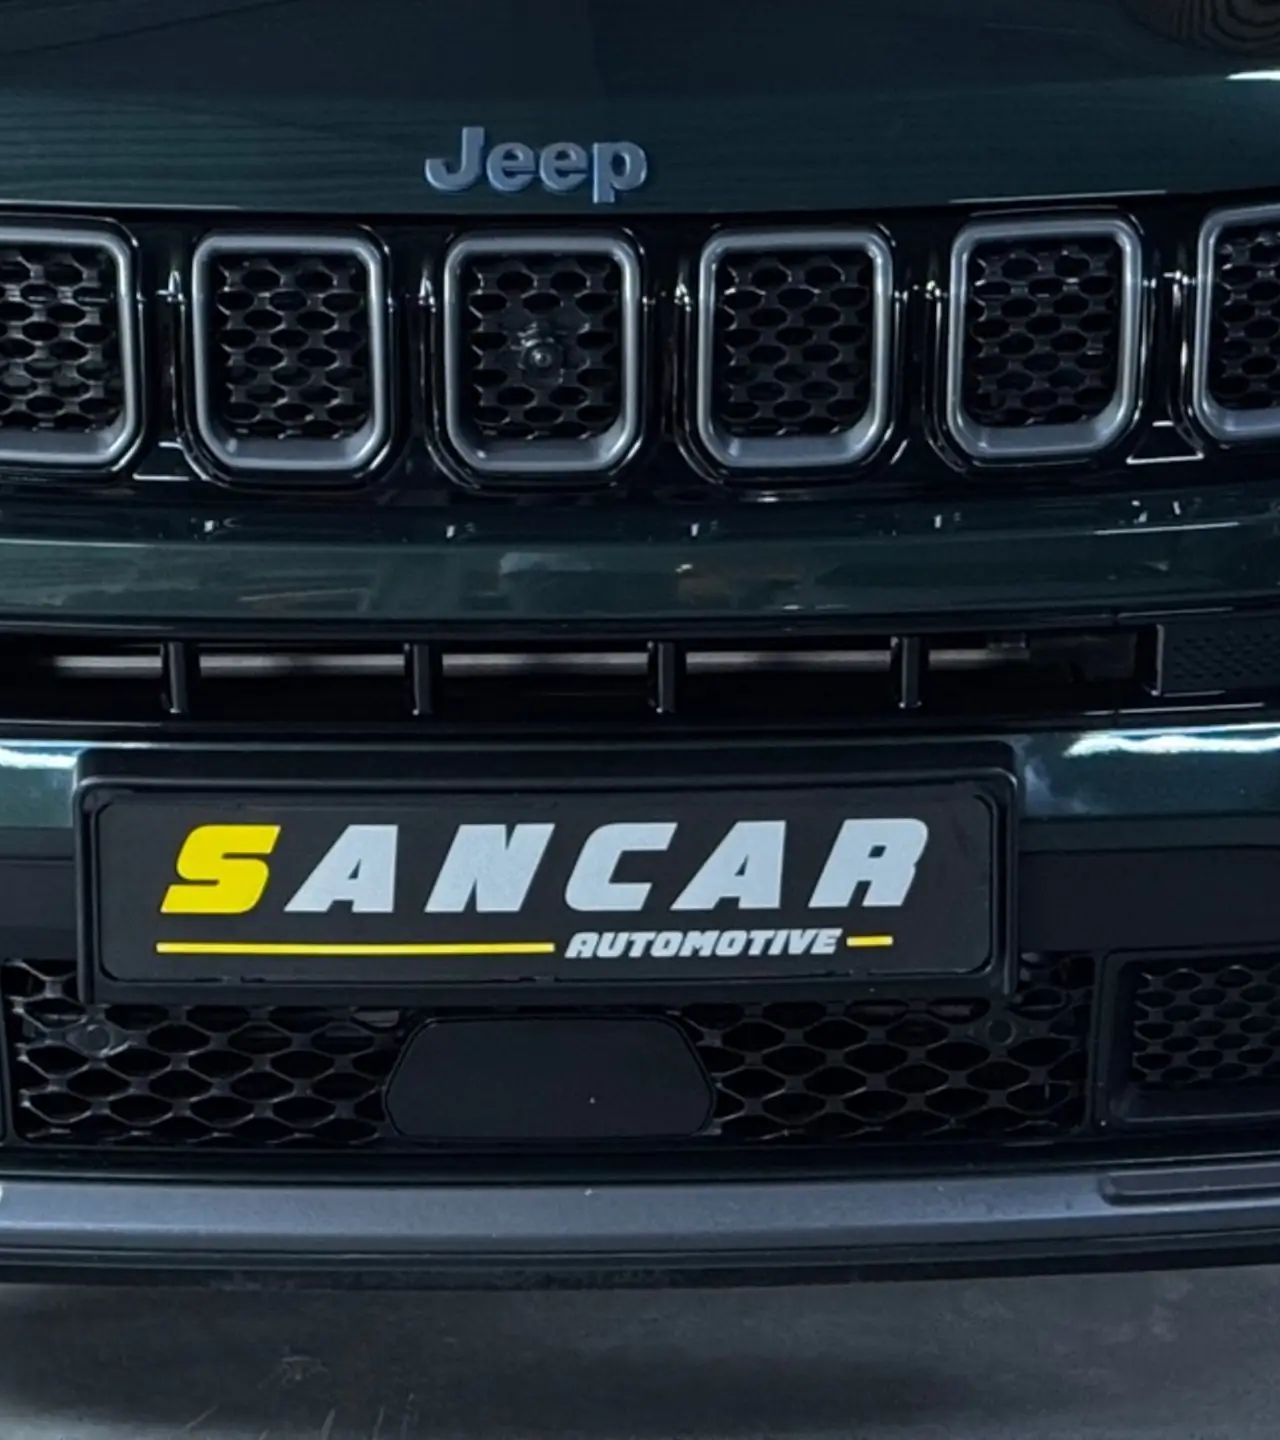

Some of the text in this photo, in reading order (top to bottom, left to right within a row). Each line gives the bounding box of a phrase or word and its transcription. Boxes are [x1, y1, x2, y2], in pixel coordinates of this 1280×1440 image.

[424, 126, 648, 203] Jeep
[159, 817, 929, 915] SANCAR
[564, 927, 843, 960] AUTOMOTIVE
